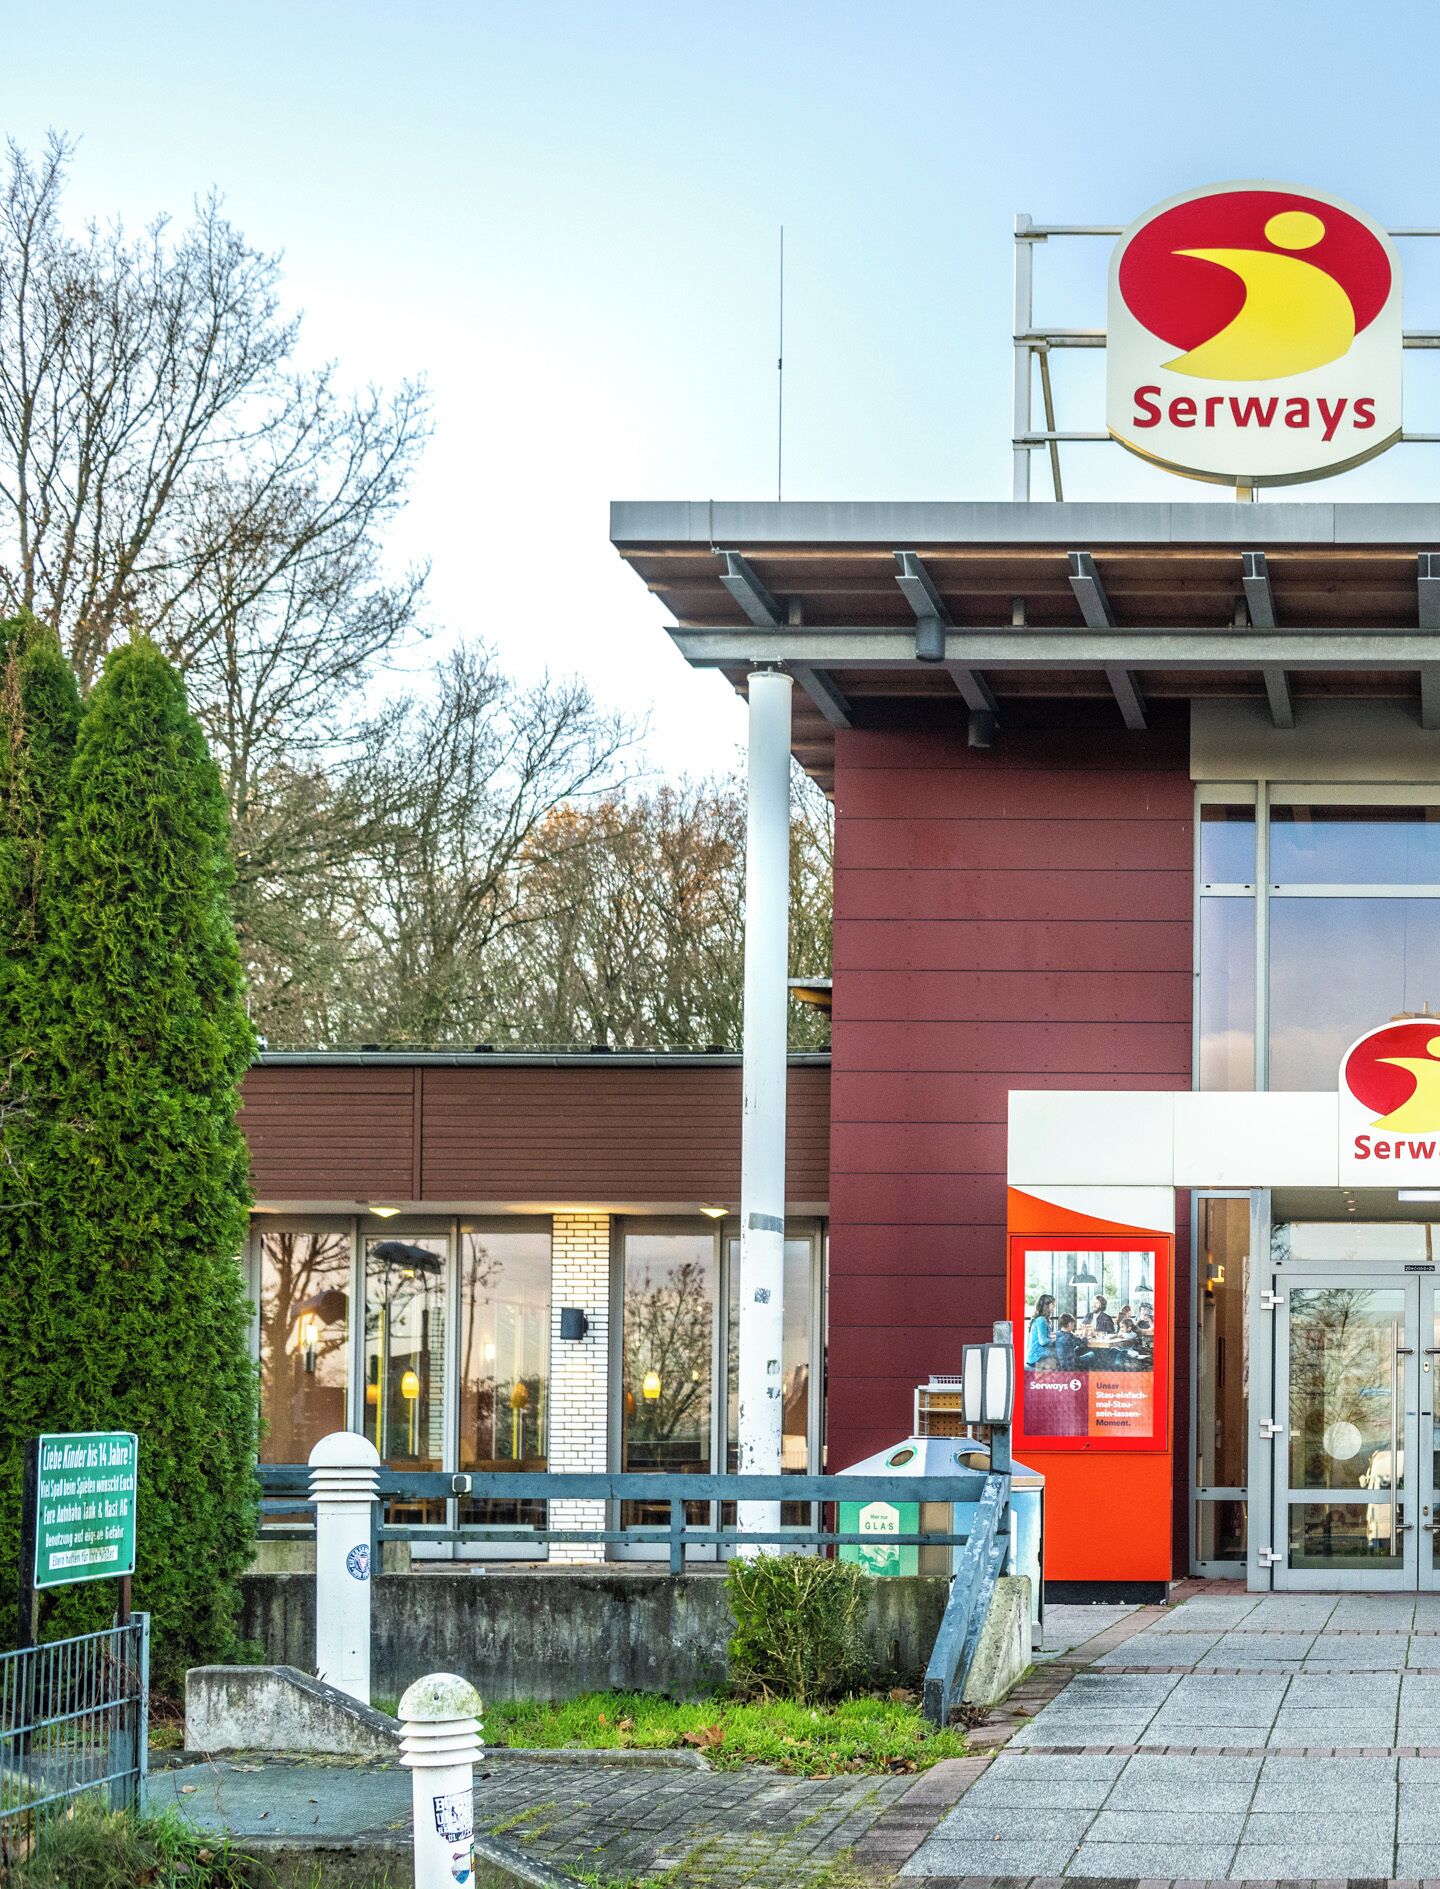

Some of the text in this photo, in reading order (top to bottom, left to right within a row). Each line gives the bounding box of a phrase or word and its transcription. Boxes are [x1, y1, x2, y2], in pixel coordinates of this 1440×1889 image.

[1132, 385, 1376, 442] Serways
[1030, 1381, 1068, 1392] Serways
[1095, 1391, 1148, 1399] Stau-einfach-
[1096, 1382, 1120, 1390] Unser
[43, 1445, 62, 1471] Liebe
[63, 1444, 87, 1469] Kinder
[87, 1443, 98, 1467] bis
[99, 1443, 107, 1467] 14
[40, 1480, 50, 1498] Viel
[51, 1478, 63, 1501] Spaß
[64, 1478, 77, 1496] beim
[77, 1476, 96, 1499] Spielen
[120, 1473, 134, 1491] Euch
[44, 1505, 56, 1525] Eure
[56, 1503, 81, 1523] Autobahn
[83, 1501, 96, 1520] Tank
[105, 1499, 118, 1518] Rast
[119, 1498, 128, 1516] AG
[45, 1532, 73, 1547] Benutzung
[74, 1529, 84, 1543] auf
[105, 1525, 124, 1540] Gefahr
[864, 1521, 894, 1531] GLAS
